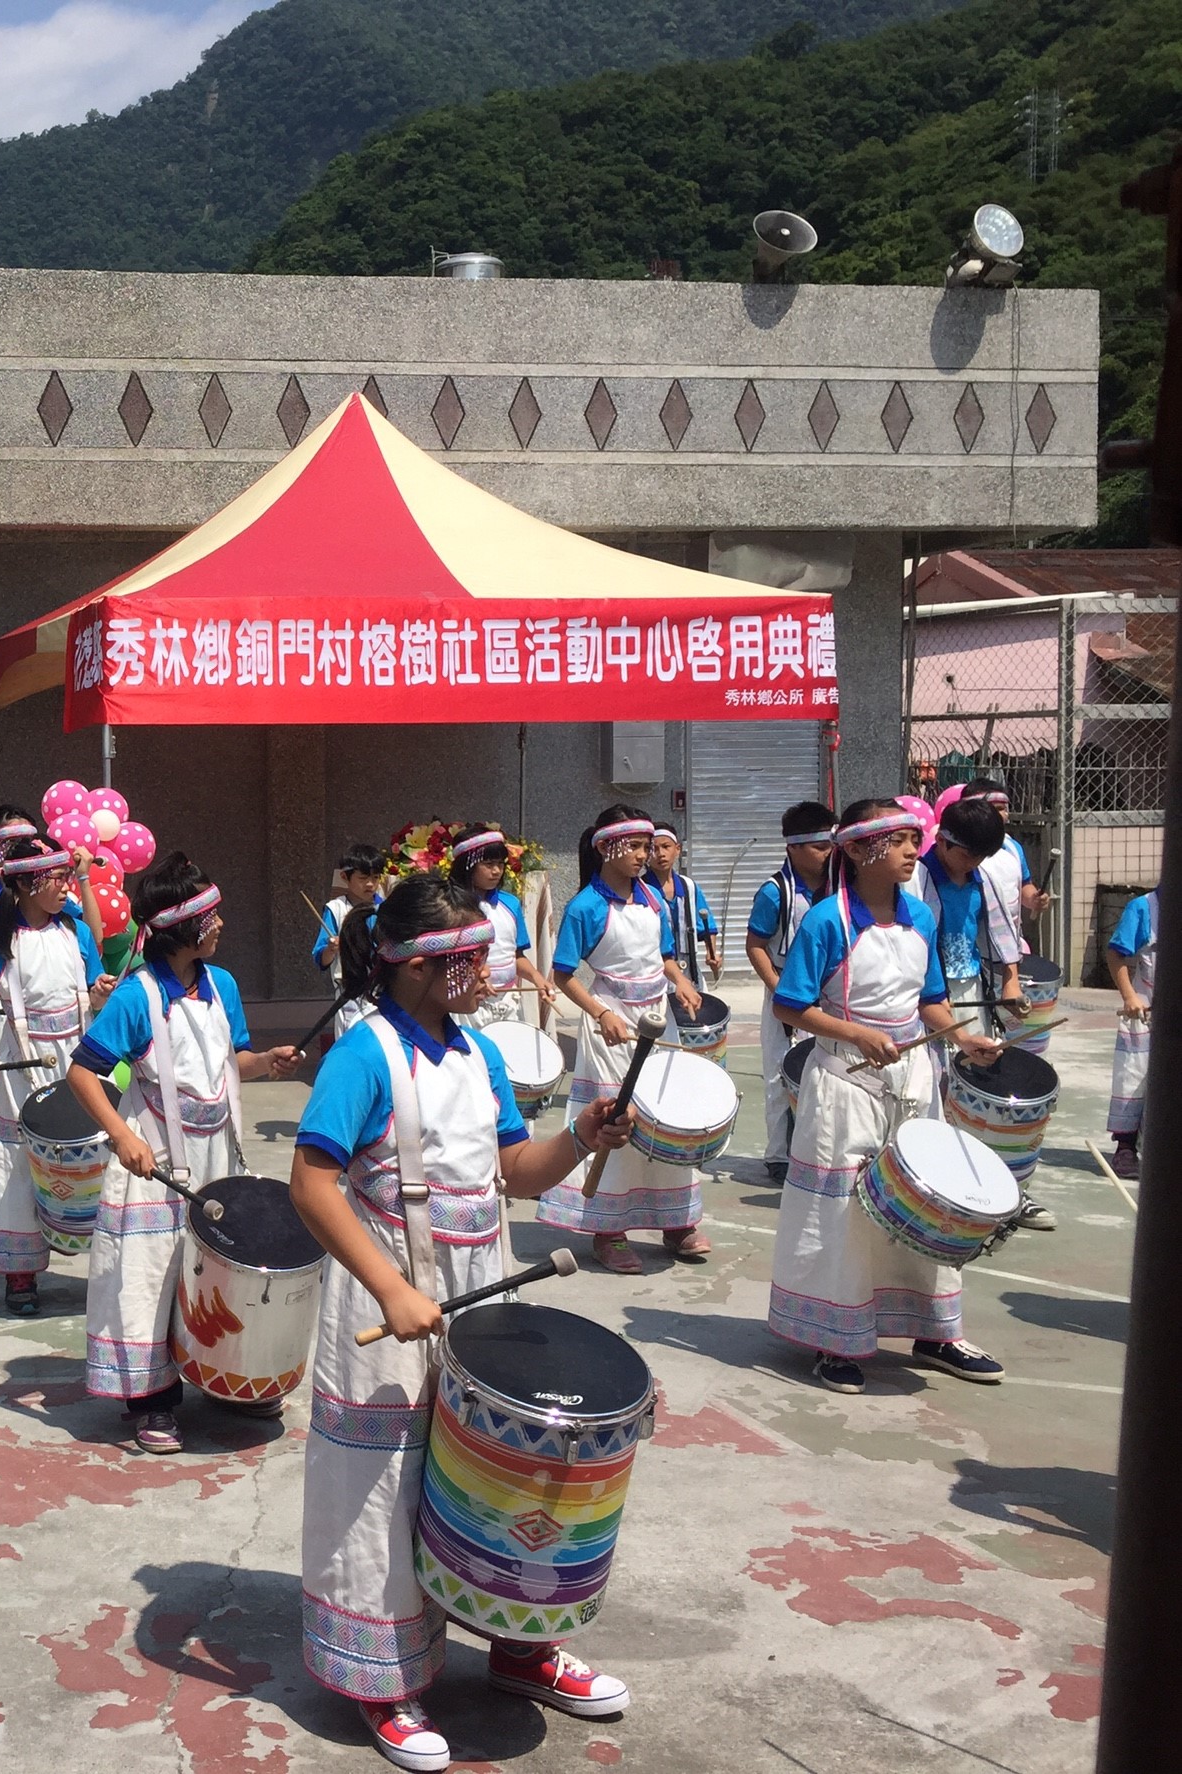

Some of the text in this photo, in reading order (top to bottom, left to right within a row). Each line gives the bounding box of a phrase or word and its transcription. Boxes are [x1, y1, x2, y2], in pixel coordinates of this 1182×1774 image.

[725, 688, 803, 706] 秀林鄉公所
